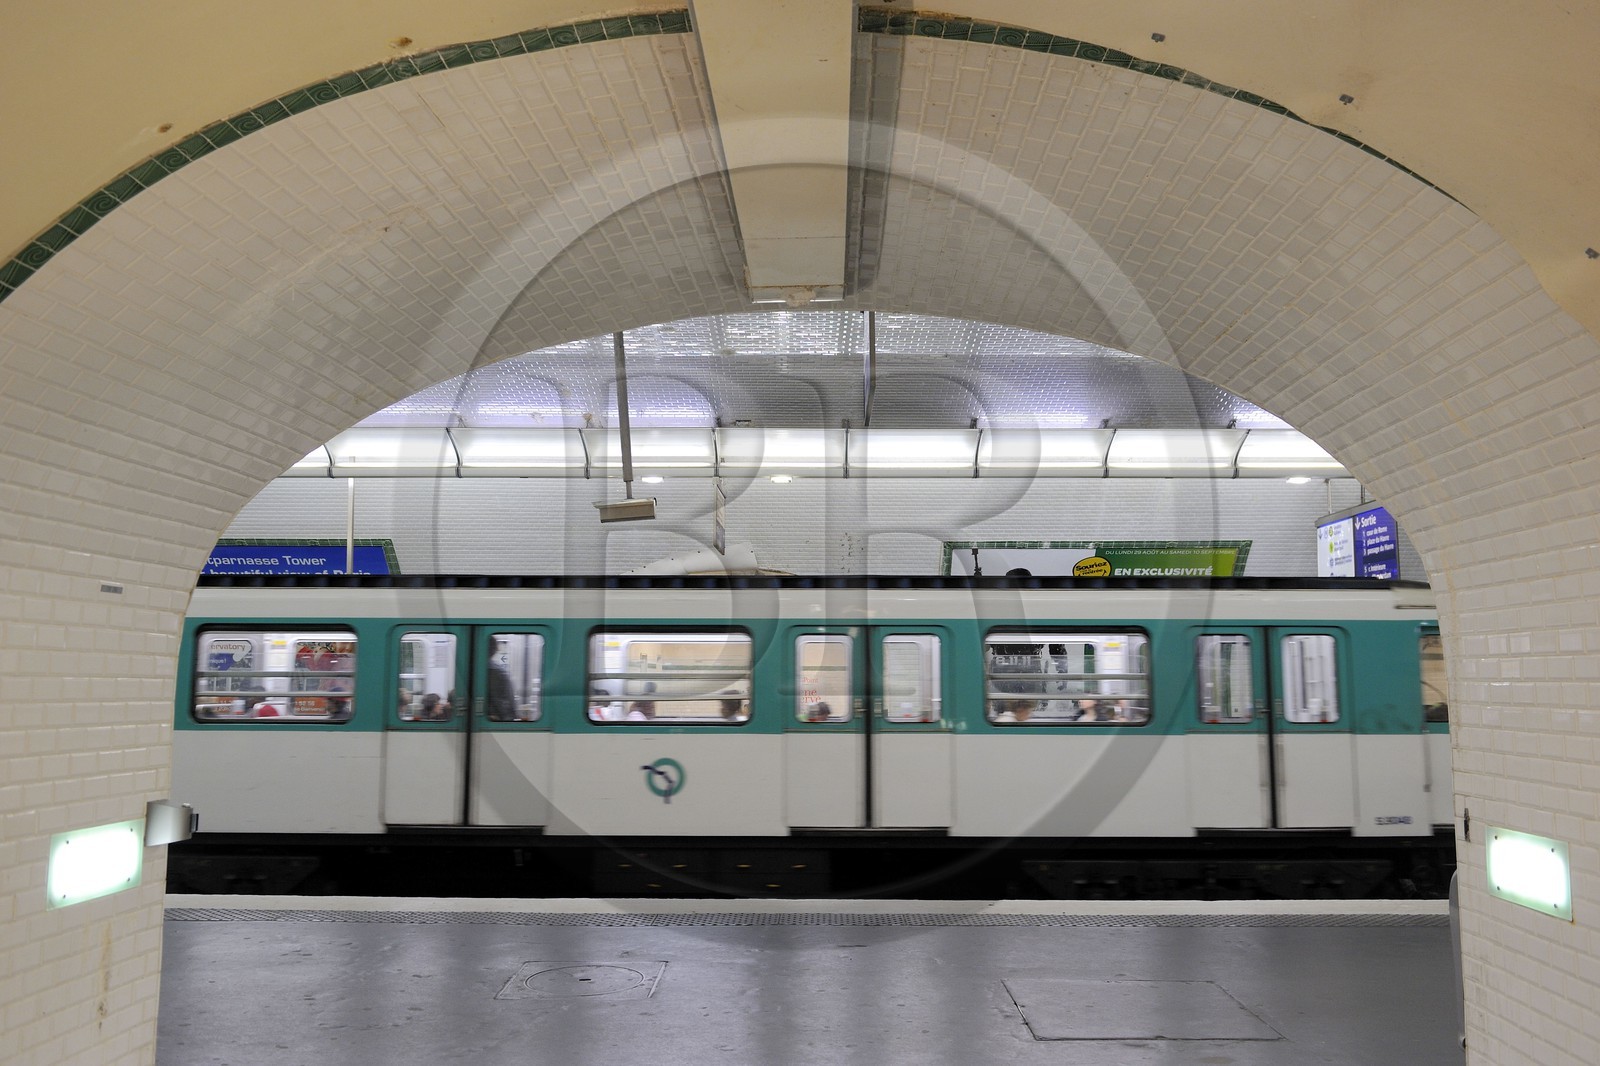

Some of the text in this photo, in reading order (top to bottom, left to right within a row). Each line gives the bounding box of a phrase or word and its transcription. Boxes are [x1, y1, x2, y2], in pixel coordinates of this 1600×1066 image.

[1361, 514, 1377, 527] Sortie
[205, 555, 326, 567] tparnasse Tower
[1076, 561, 1107, 571] Souriez
[1114, 565, 1214, 576] EN EXCLUSIVITÉ
[209, 643, 246, 651] ervatory
